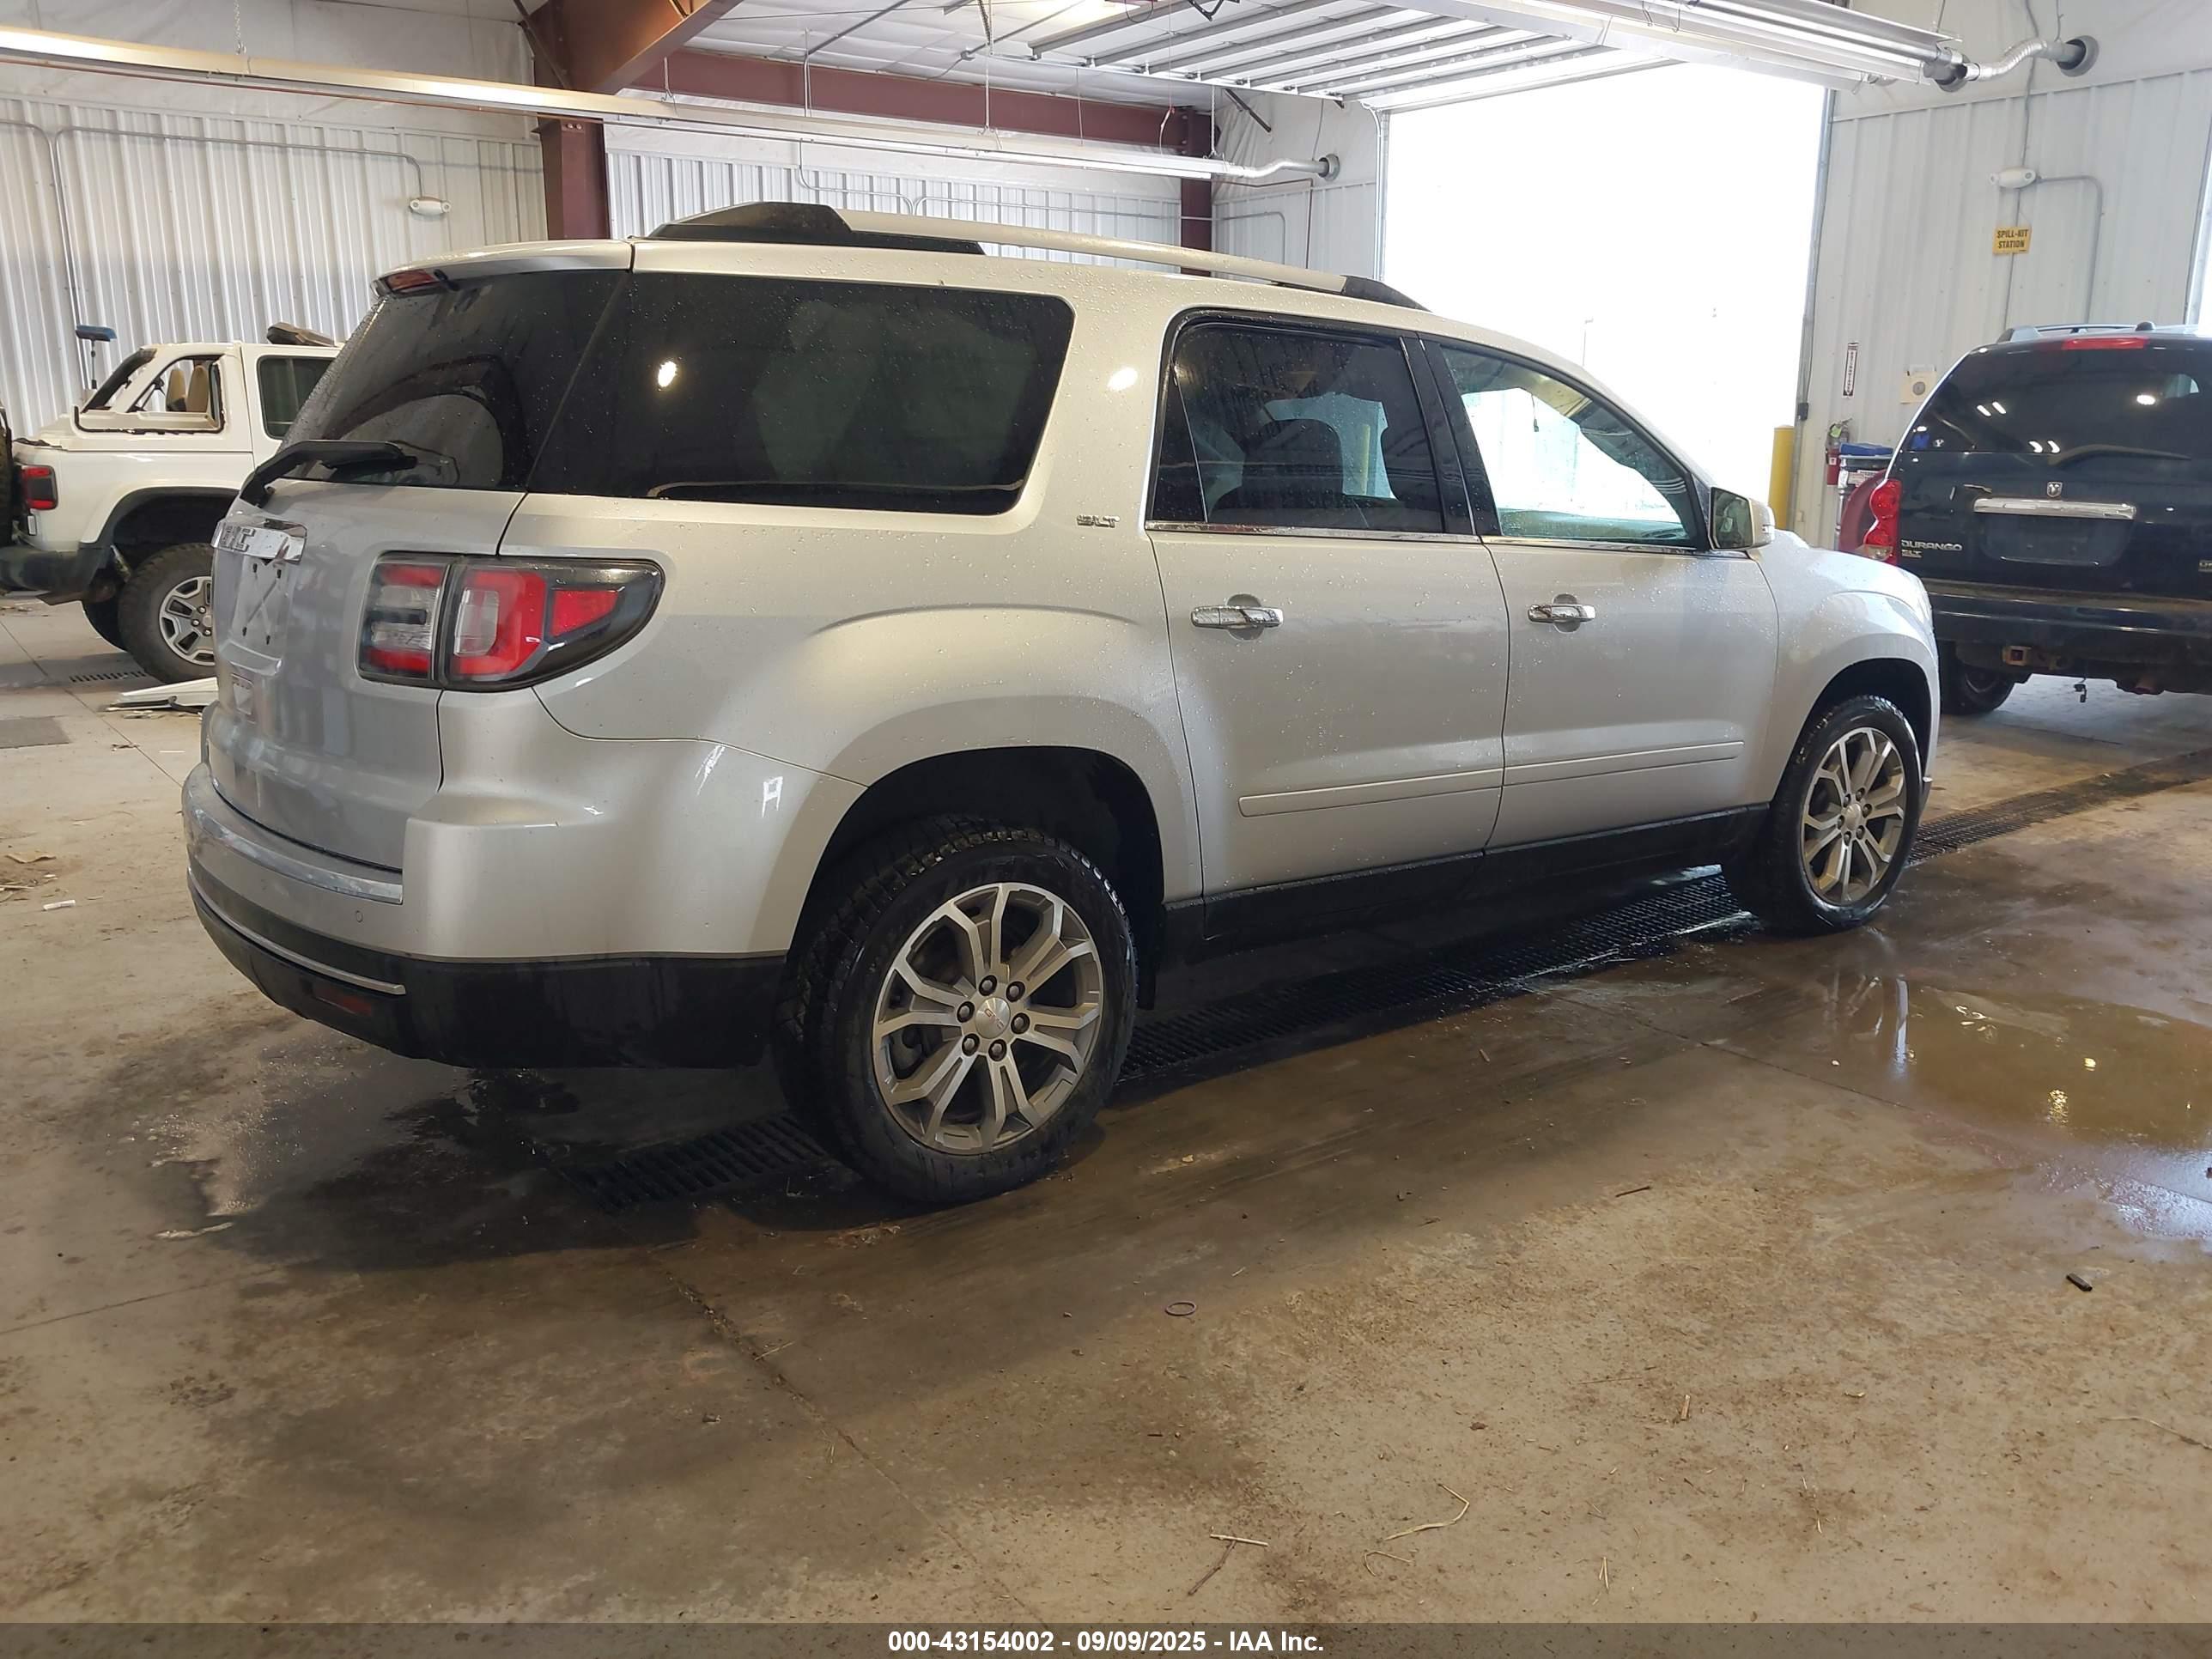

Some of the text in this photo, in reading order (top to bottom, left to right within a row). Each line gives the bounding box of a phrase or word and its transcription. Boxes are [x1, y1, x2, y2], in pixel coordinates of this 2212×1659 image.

[1997, 228, 2028, 239] SPILL-KIT
[1998, 240, 2025, 249] STATION
[1901, 539, 1963, 551] DURANGO
